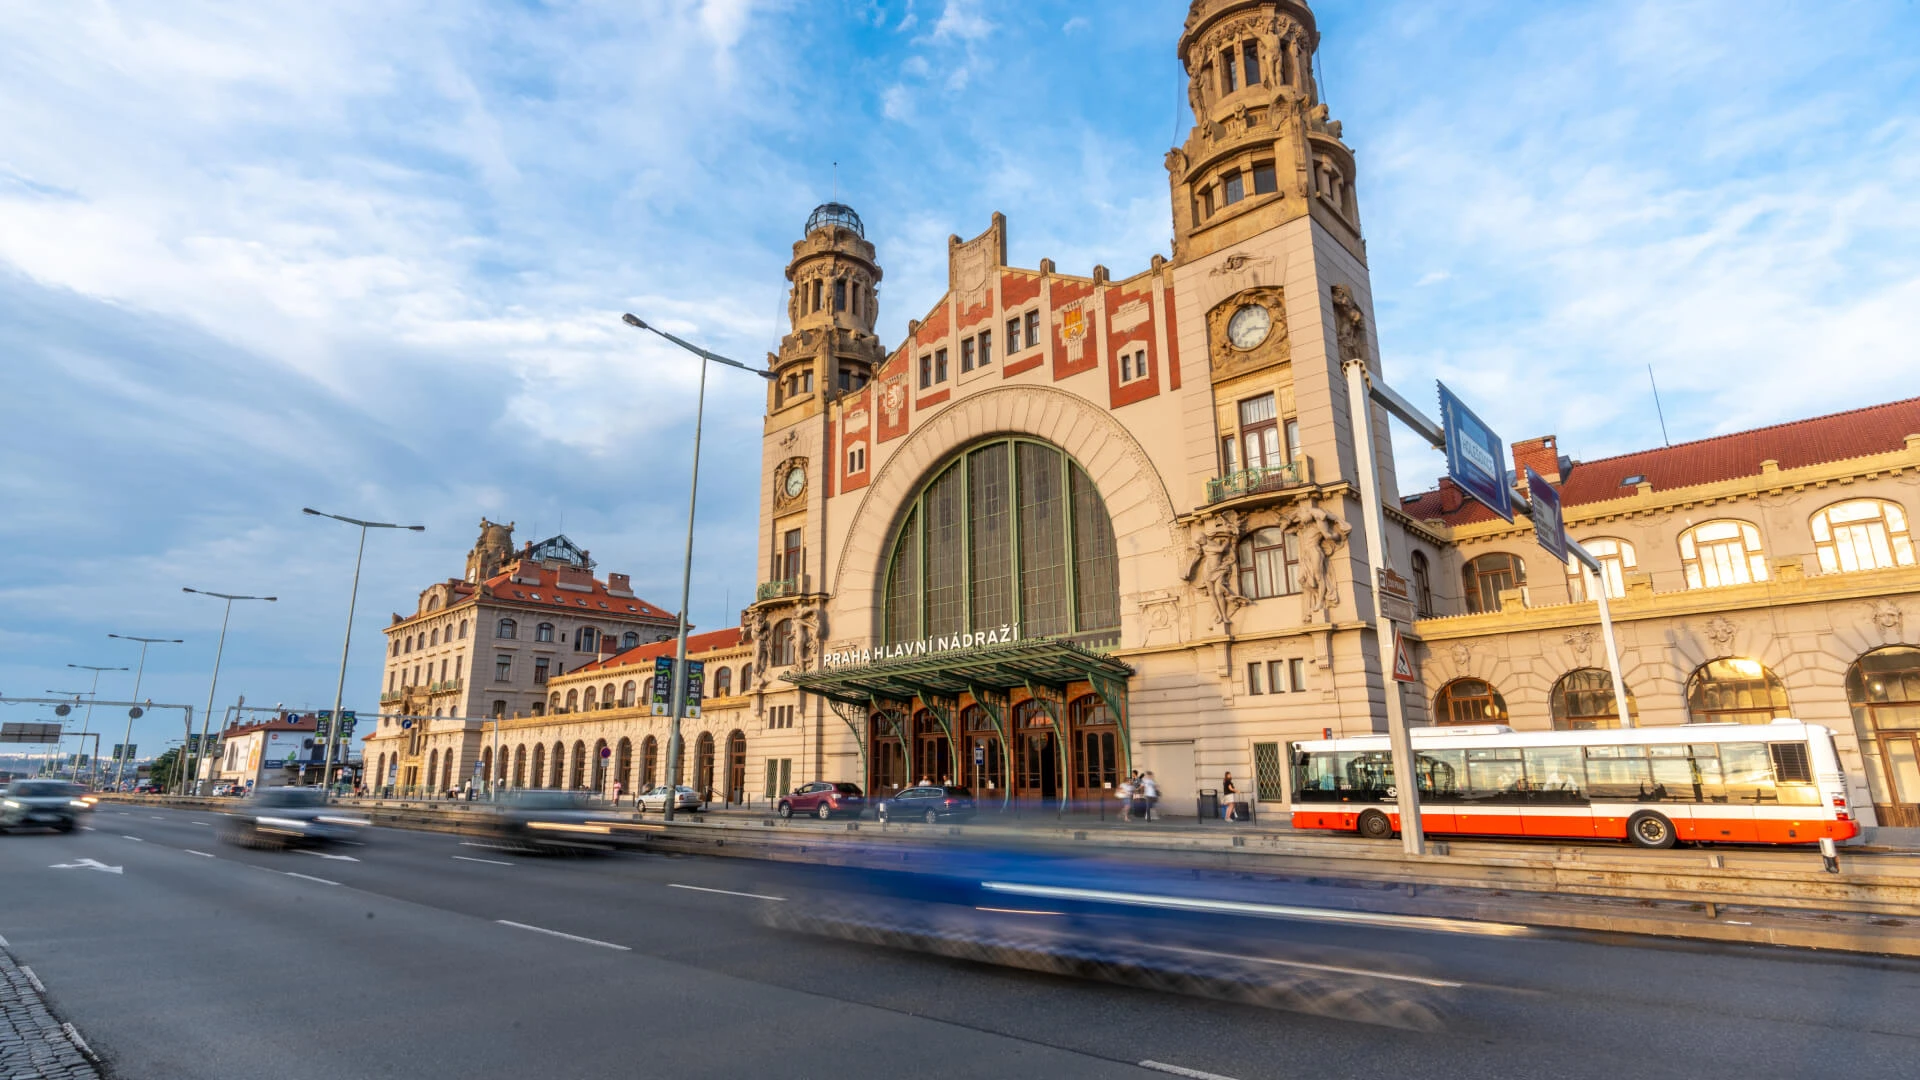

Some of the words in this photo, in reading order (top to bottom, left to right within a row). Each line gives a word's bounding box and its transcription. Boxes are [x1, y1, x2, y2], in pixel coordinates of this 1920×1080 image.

[823, 648, 872, 666] PRAHA
[874, 635, 934, 660] HLAVNÍ
[938, 622, 1019, 651] NÁDRAŽÍ
